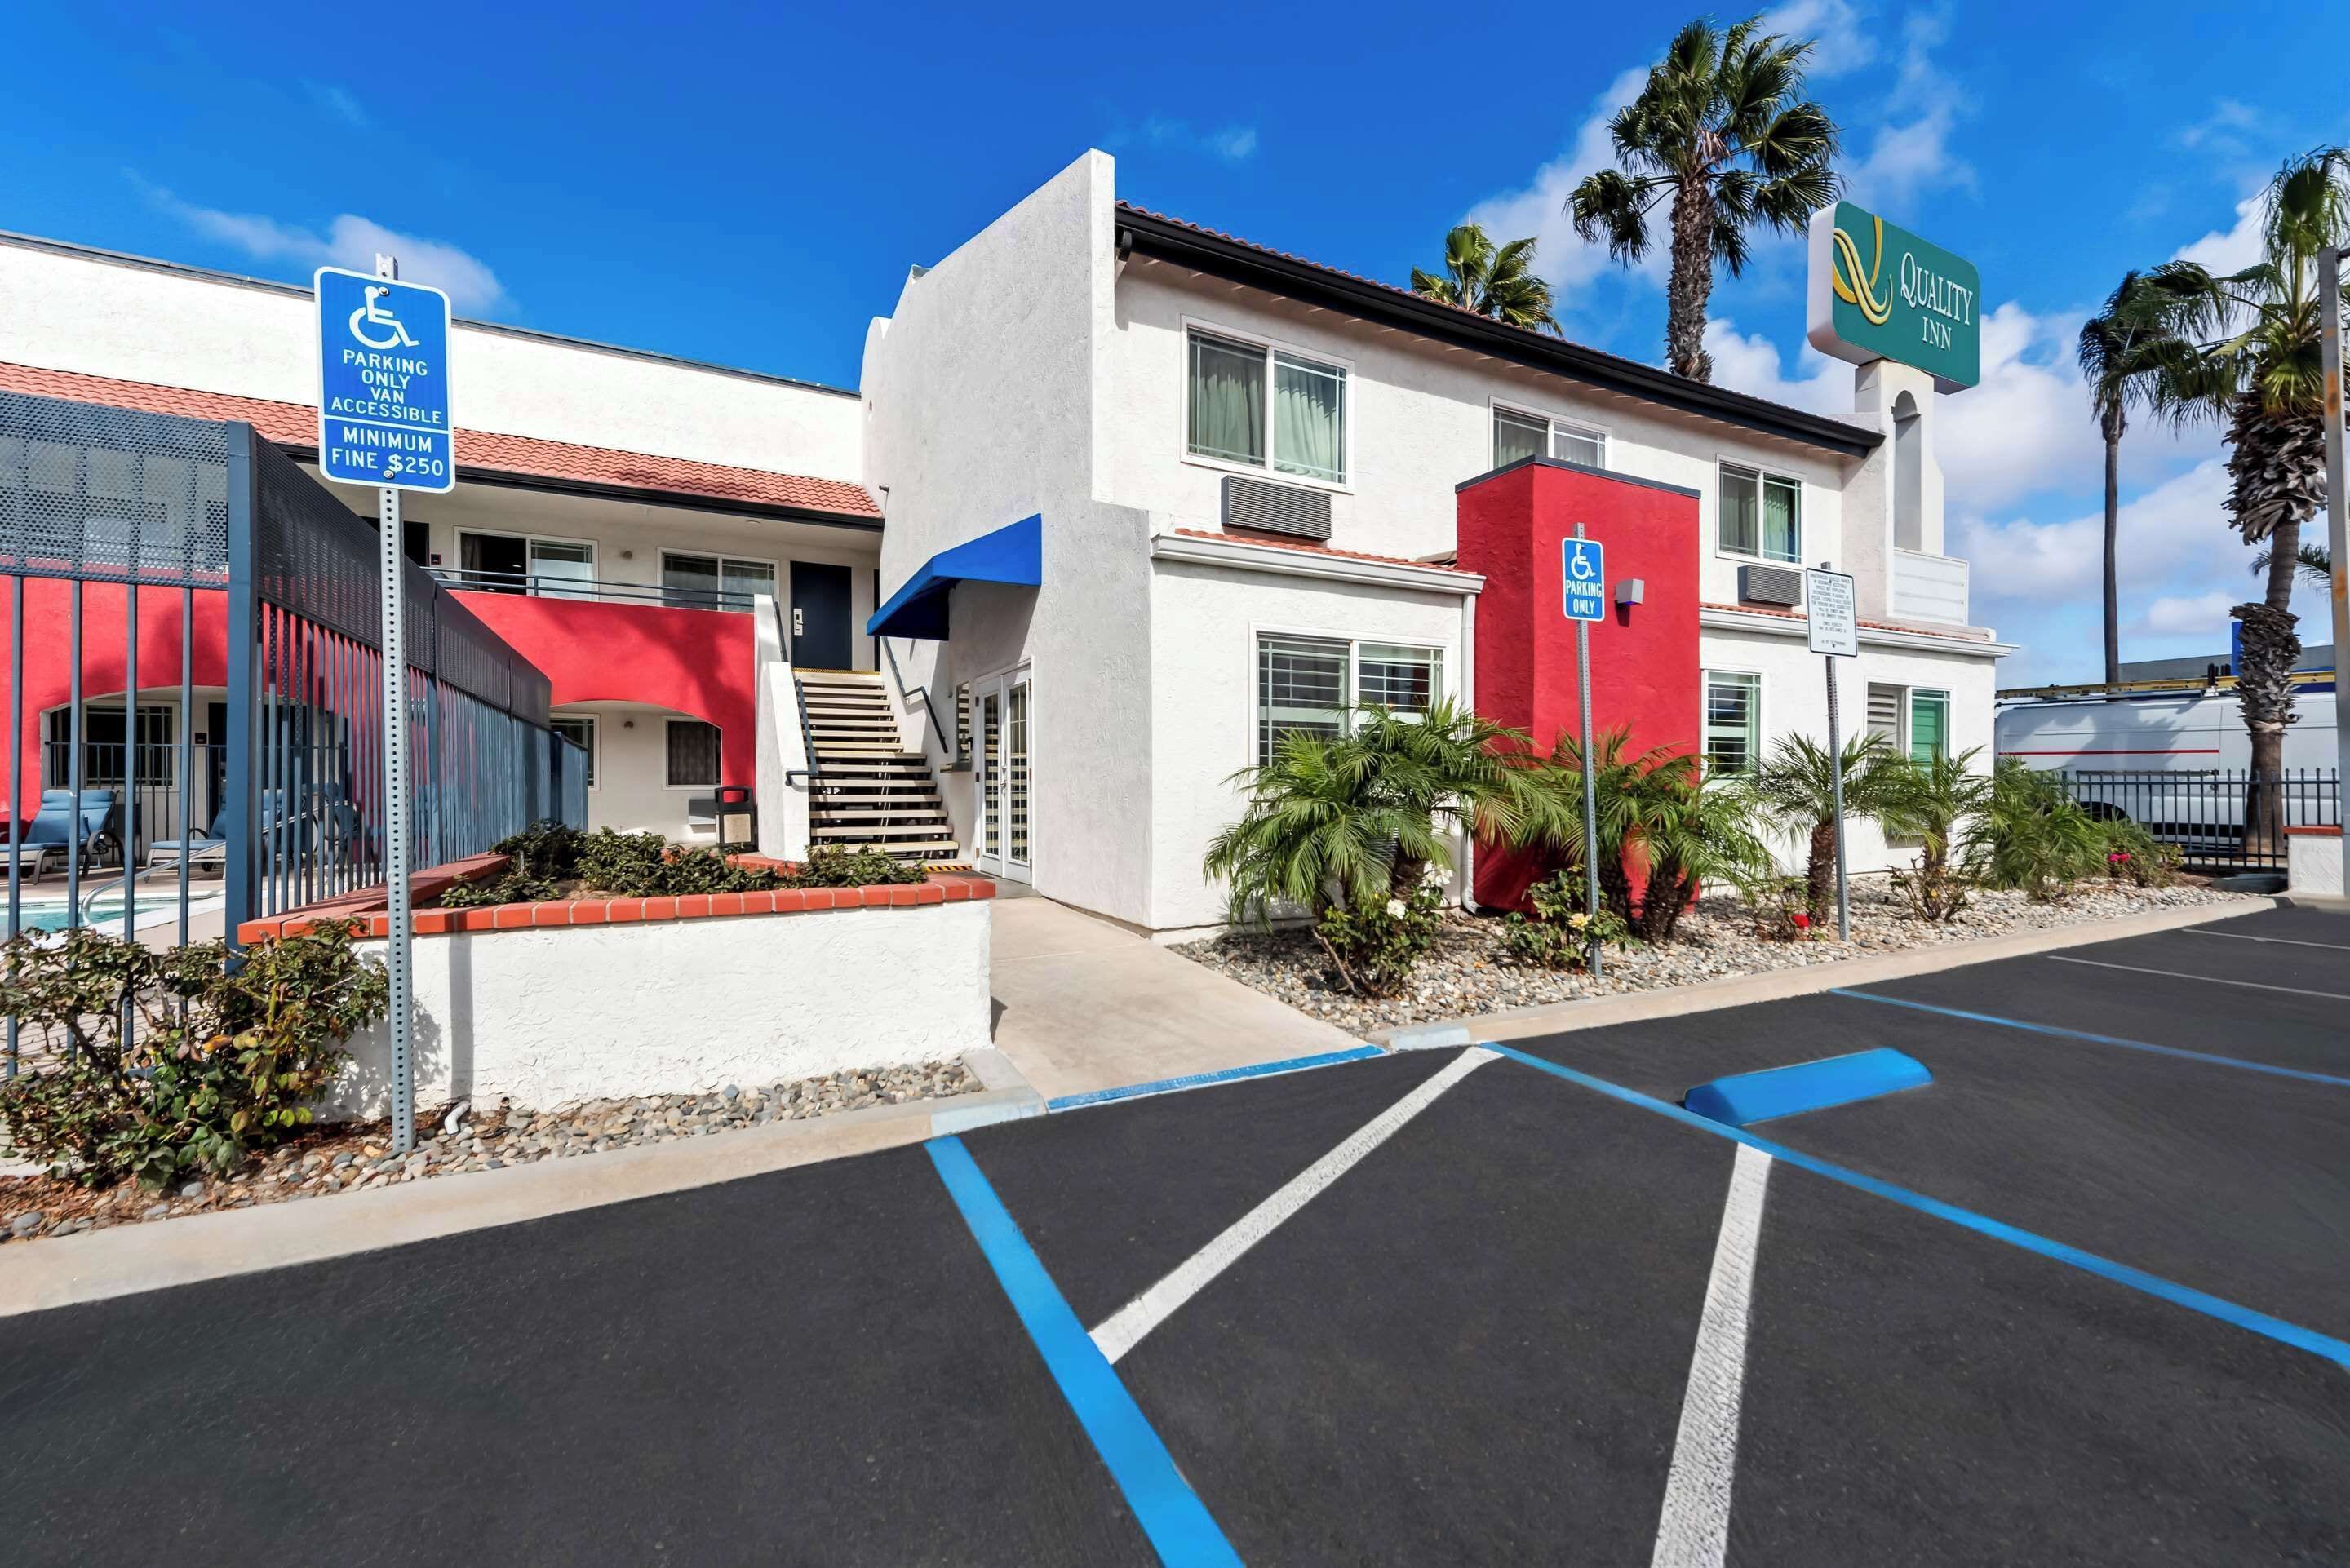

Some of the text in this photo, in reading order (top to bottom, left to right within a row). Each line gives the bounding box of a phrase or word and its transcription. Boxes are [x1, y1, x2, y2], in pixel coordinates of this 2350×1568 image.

[1900, 251, 1973, 326] QUALITY
[1922, 317, 1952, 352] INN
[343, 349, 428, 376] PARKING
[361, 370, 410, 389] ONLY
[370, 387, 404, 404] VAN
[331, 396, 441, 424] ACCESSIBLE
[343, 427, 432, 453] MINIMUM
[332, 448, 443, 476] FINE $250
[1566, 579, 1602, 598] PARKING
[1573, 598, 1595, 614] ONLY
